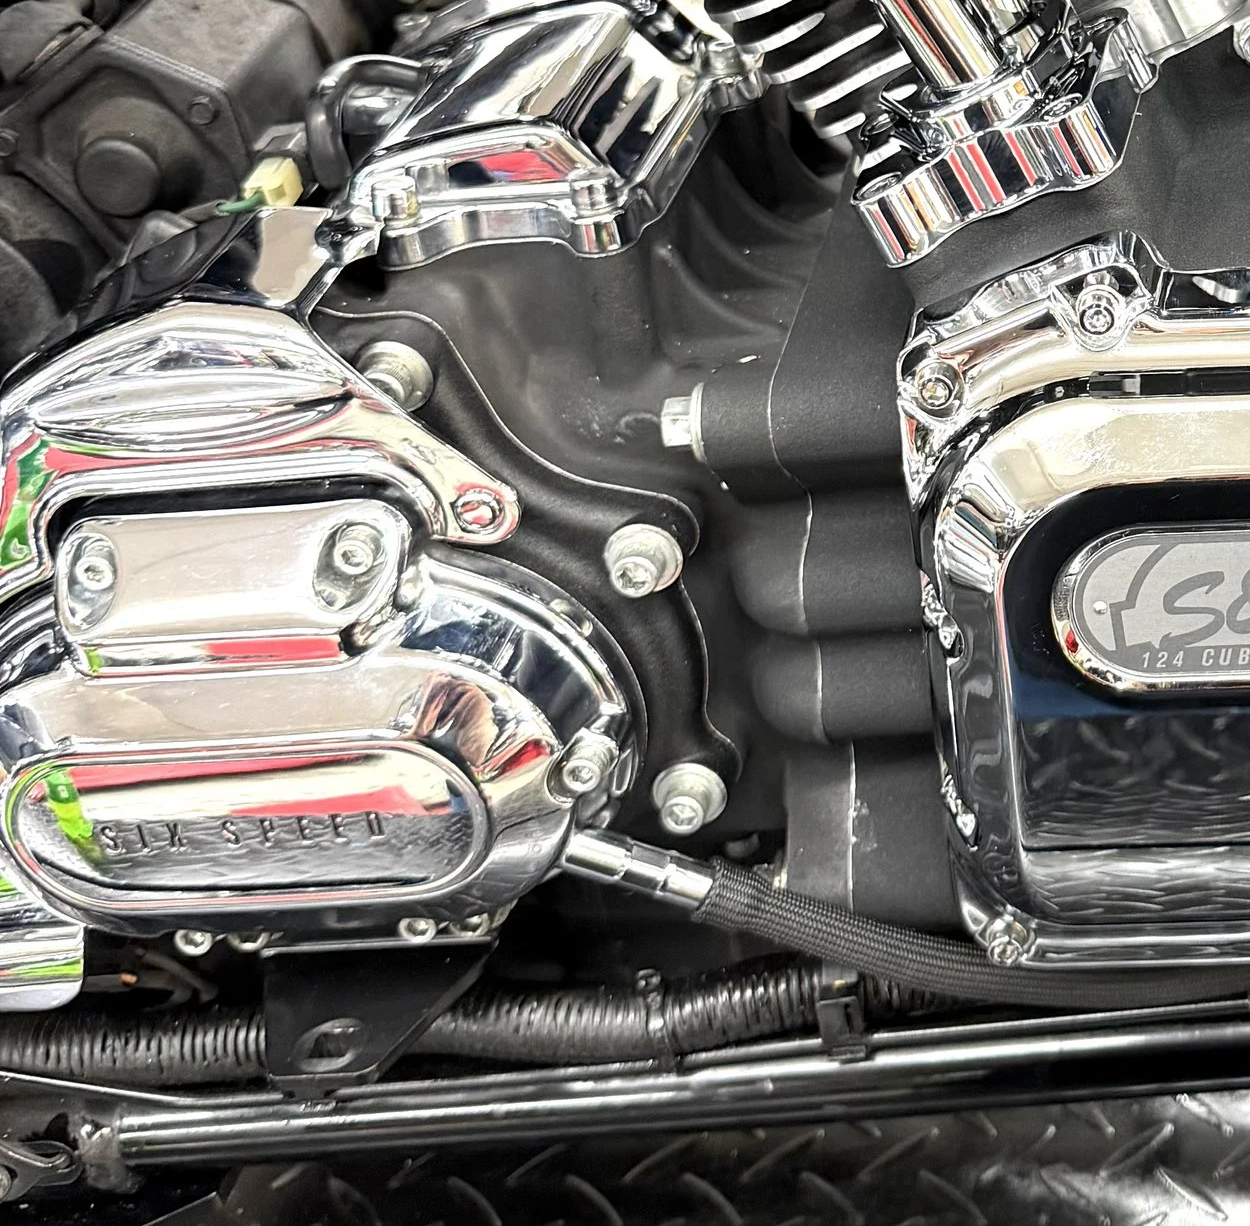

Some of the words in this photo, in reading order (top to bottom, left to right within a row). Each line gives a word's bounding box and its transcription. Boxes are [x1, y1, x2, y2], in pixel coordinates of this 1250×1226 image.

[1142, 650, 1184, 668] 124
[101, 823, 184, 853] SIX
[222, 812, 386, 847] SPEED
